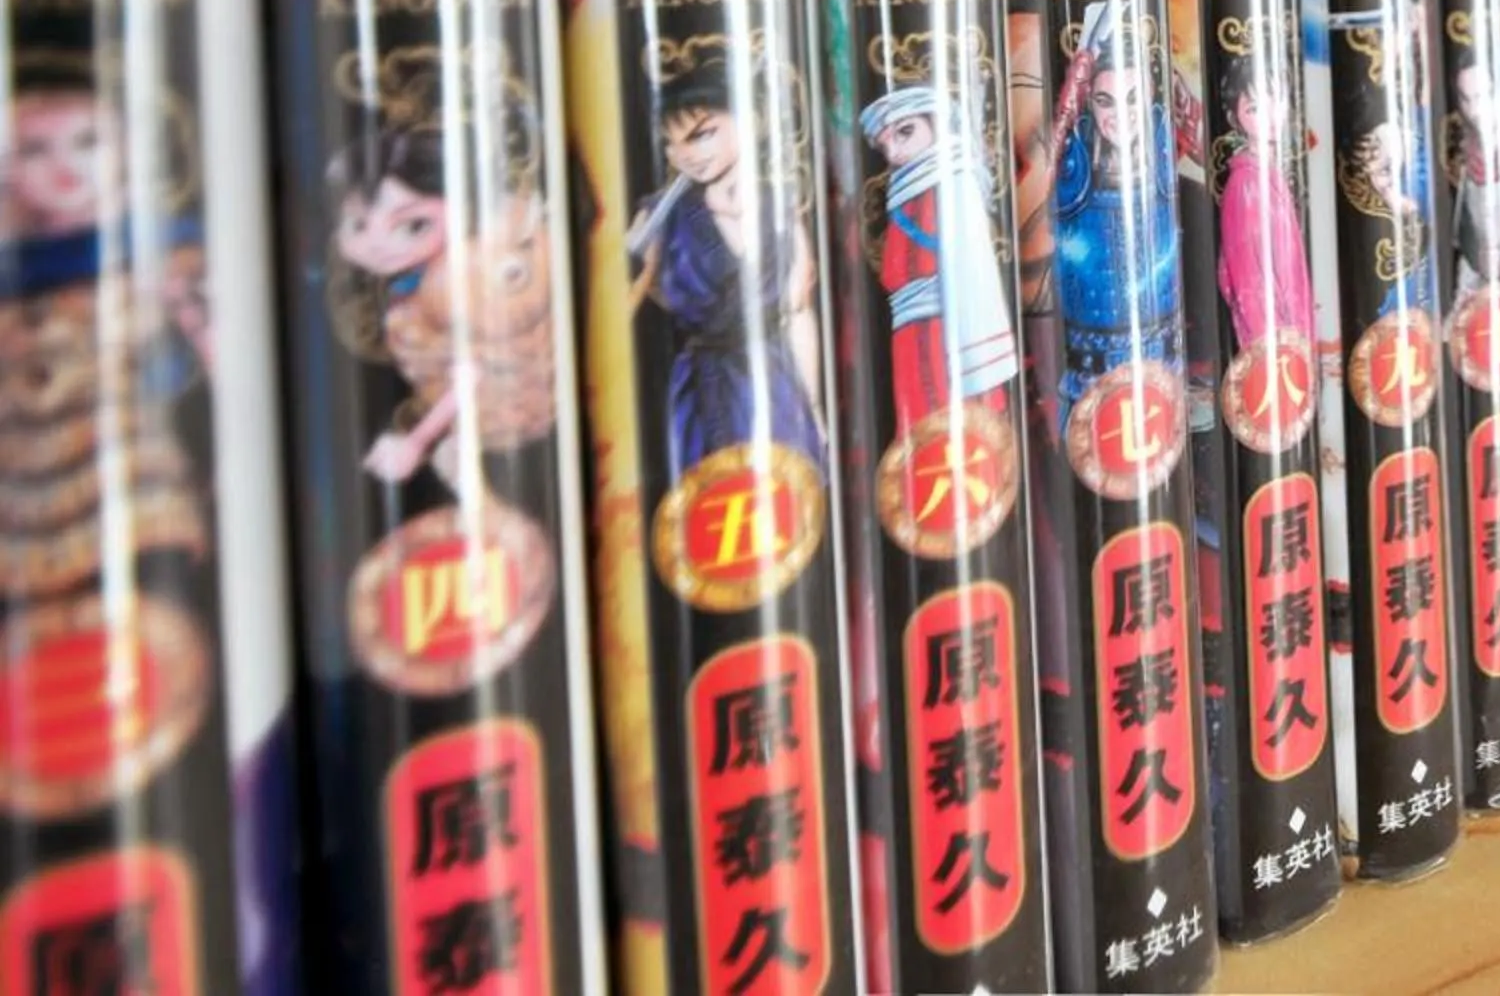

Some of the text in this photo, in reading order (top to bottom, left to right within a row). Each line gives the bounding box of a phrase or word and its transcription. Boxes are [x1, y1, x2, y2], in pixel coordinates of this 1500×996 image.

[1252, 357, 1306, 422] 八
[1378, 339, 1426, 395] 九
[1099, 395, 1162, 463] 七
[701, 477, 789, 572] 五
[914, 436, 991, 523] 六
[402, 547, 506, 655] 四
[1257, 501, 1320, 749] 原泰久
[1382, 474, 1441, 704] 原泰久
[1107, 553, 1184, 826] 原泰久
[923, 616, 1010, 915] 原泰久
[1377, 777, 1455, 835] 集英社
[708, 673, 810, 996] 原泰久
[1252, 823, 1336, 890] 集英社
[1104, 905, 1204, 979] 集英社
